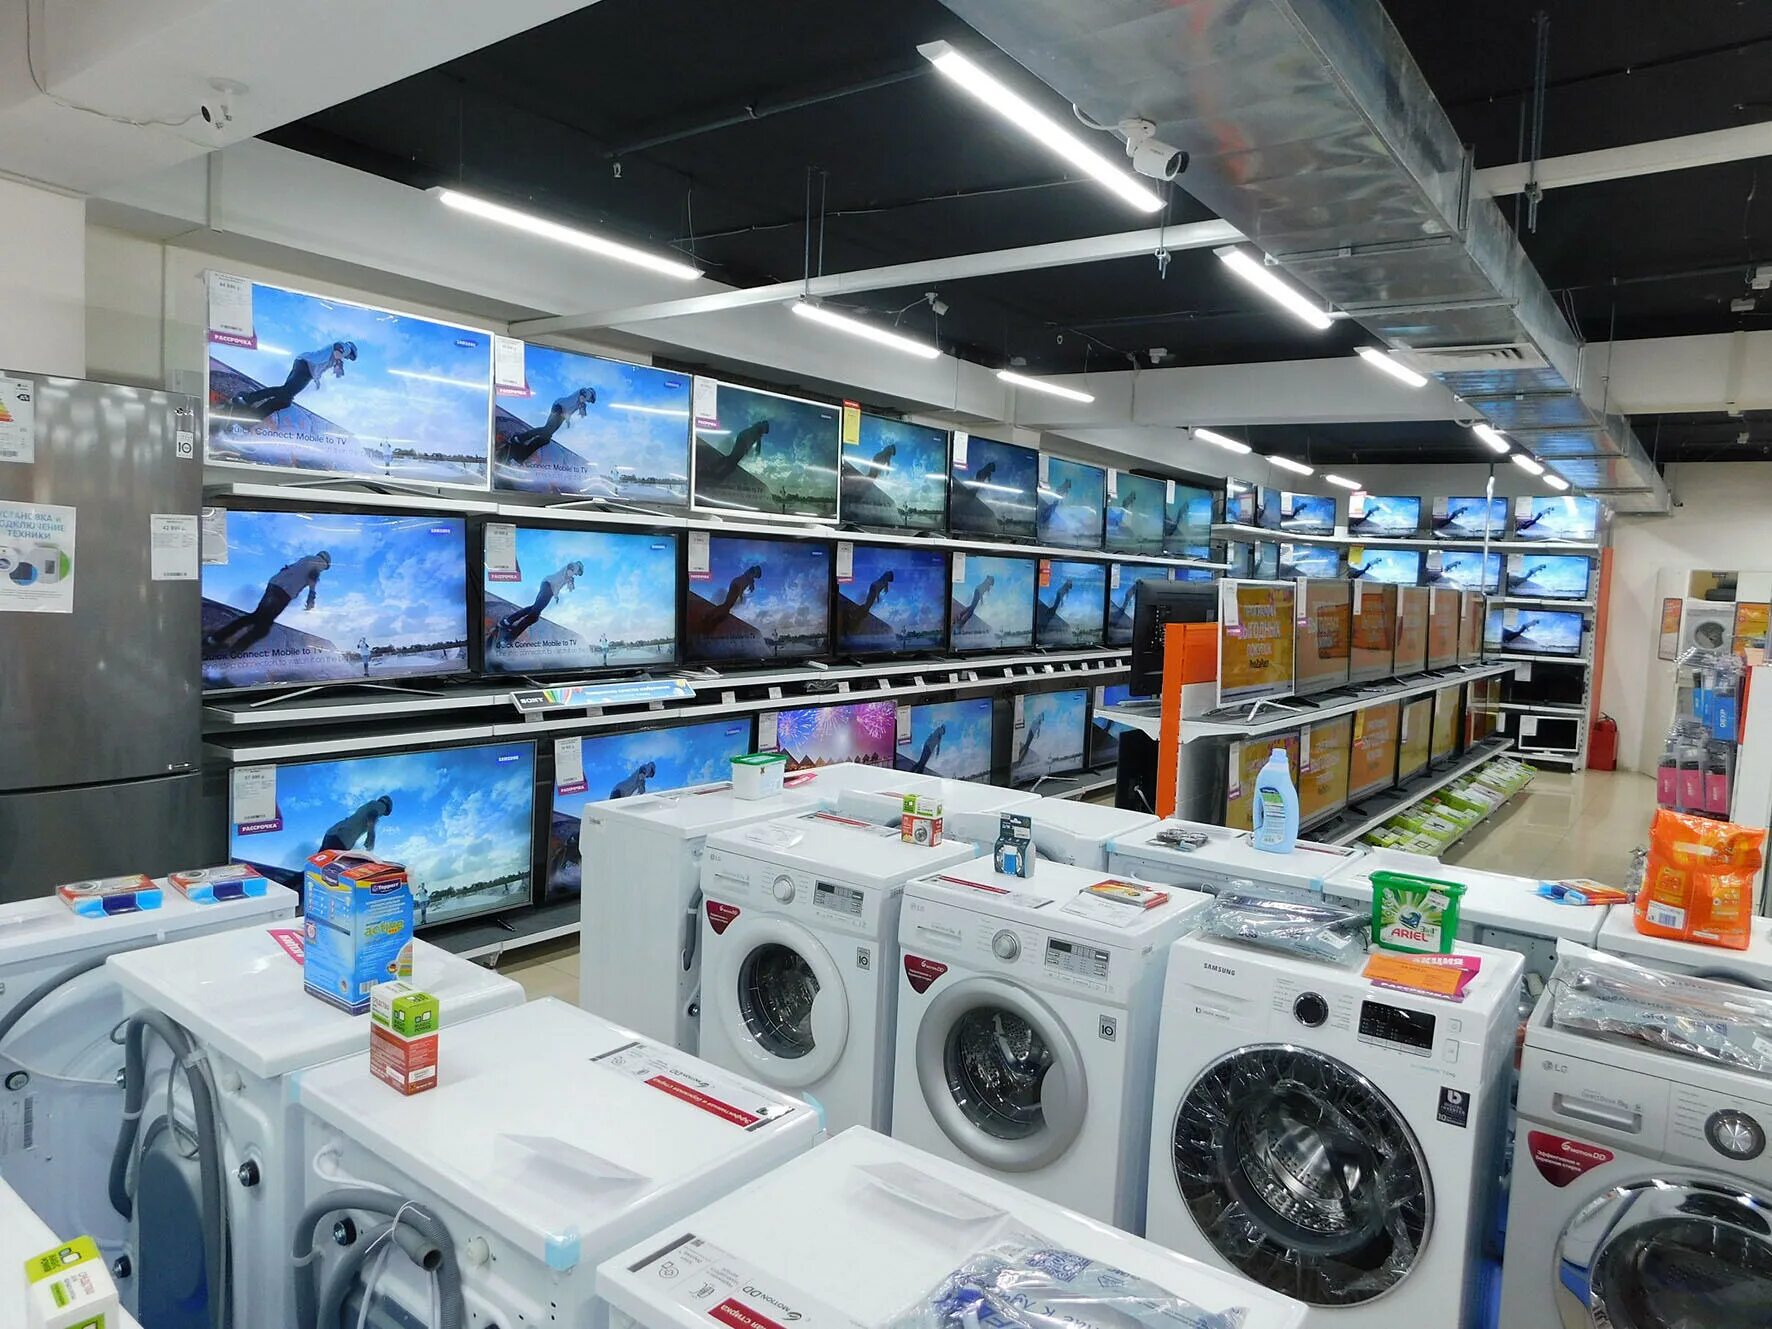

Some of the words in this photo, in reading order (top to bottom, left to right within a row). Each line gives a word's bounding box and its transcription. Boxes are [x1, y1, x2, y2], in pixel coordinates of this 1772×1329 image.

[255, 427, 295, 441] Connect:
[296, 432, 324, 445] Mobile
[326, 436, 334, 444] to
[337, 437, 347, 446] TV
[8, 528, 52, 540] ТЕХНИКИ
[515, 640, 542, 650] Connect:
[542, 639, 562, 648] Mobile
[562, 639, 569, 647] to
[230, 648, 270, 661] Connect:
[271, 647, 300, 658] Mobile
[302, 647, 311, 656] to
[520, 696, 544, 705] SONY
[241, 823, 278, 832] РАССРОЧКА
[1391, 927, 1429, 942] ARIEL
[1203, 962, 1236, 976] SAMSUNG
[1554, 1064, 1569, 1074] LG
[720, 1304, 750, 1325] стирка
